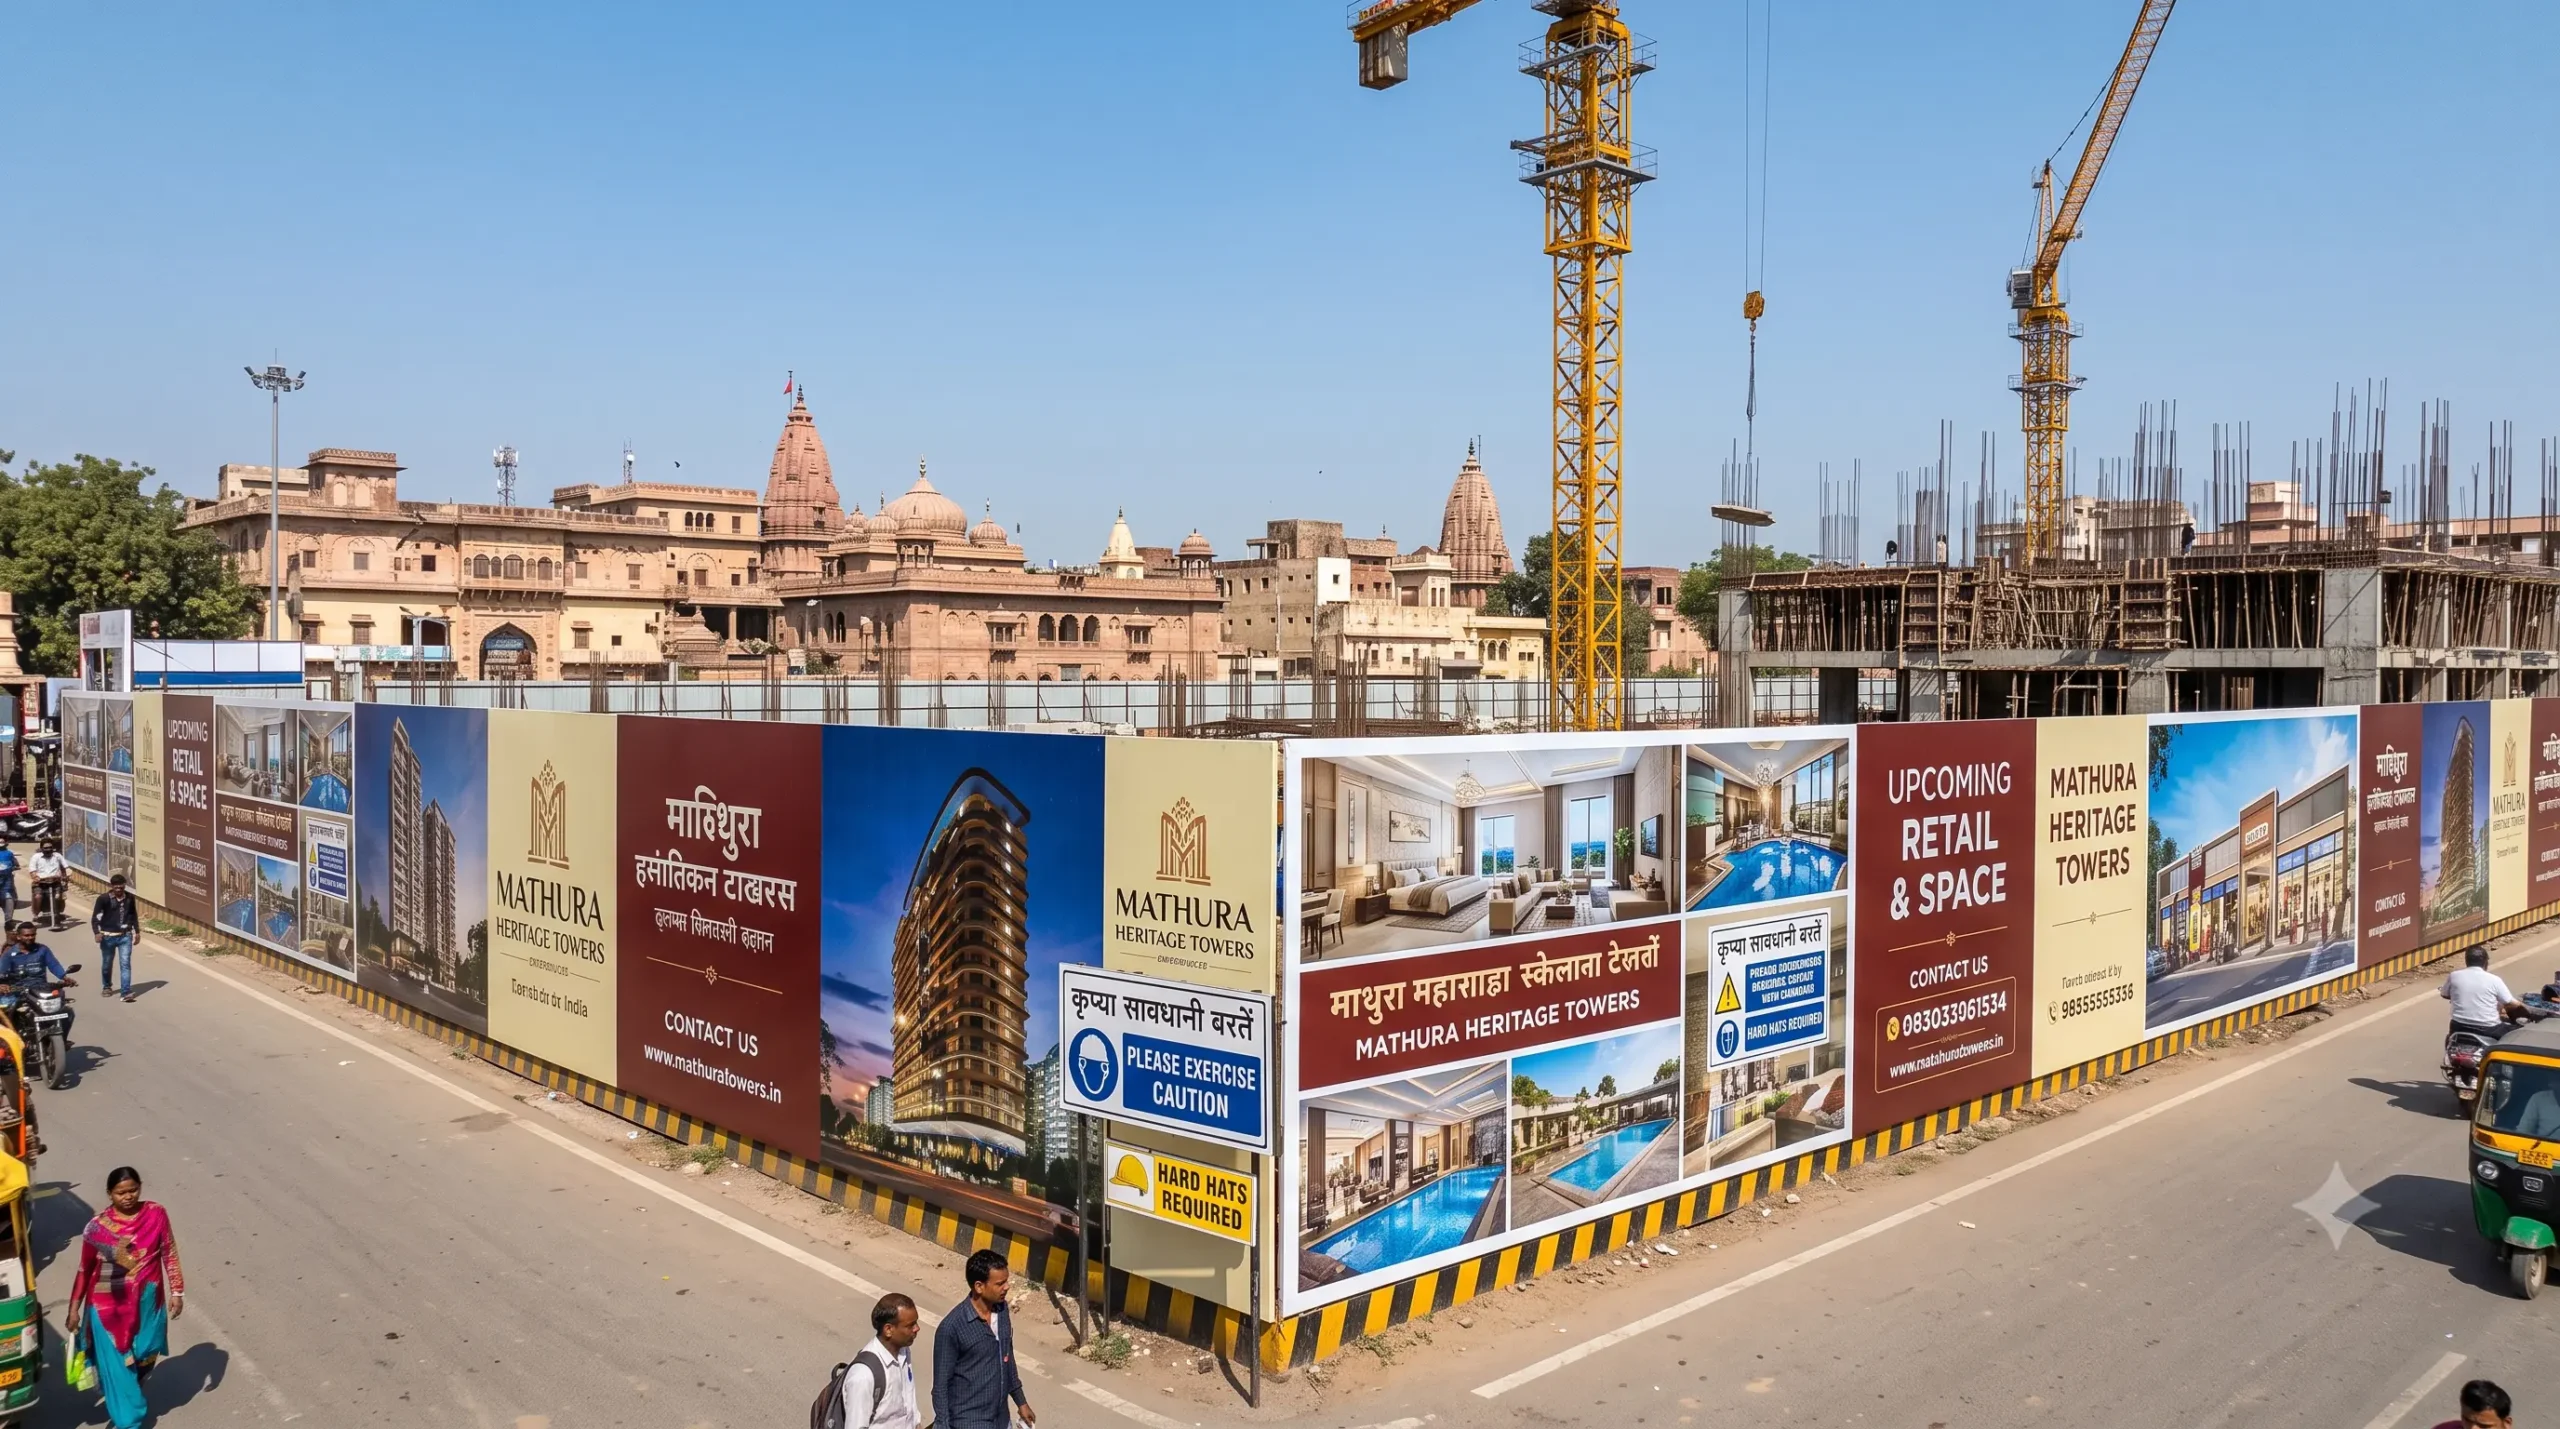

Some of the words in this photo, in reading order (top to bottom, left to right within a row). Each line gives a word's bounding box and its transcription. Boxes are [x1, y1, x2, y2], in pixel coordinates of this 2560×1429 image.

[167, 719, 208, 742] UPCOMING
[172, 748, 203, 776] RETAIL
[1888, 761, 2011, 804] UPCOMING
[2050, 762, 2137, 799] MATHURA
[169, 779, 176, 803] &
[177, 781, 208, 810] SPACE
[1902, 810, 1999, 861] RETAIL
[2050, 803, 2137, 843] HERITAGE
[2056, 846, 2130, 886] TOWERS
[497, 870, 605, 932] MATHURA
[1116, 887, 1254, 933] MATHURA
[1890, 876, 1910, 921] &
[1918, 861, 2007, 916] SPACE
[496, 916, 551, 949] HERITAGE
[553, 931, 605, 965] TOWERS
[1115, 924, 1186, 950] HERITAGE
[1189, 935, 1254, 960] TOWERS
[1749, 922, 1796, 953] सावधानी
[1909, 959, 1969, 989] CONTACT
[1972, 955, 1989, 975] US
[1071, 987, 1117, 1020] कृप्या
[1122, 997, 1205, 1033] सावधानी
[1210, 1006, 1254, 1041] बरतें
[1329, 980, 1408, 1026] माथुरा
[664, 1010, 734, 1049] CONTACT
[738, 1031, 759, 1057] US
[1356, 1022, 1459, 1061] MATHURA
[1465, 1003, 1559, 1041] HERITAGE
[1564, 989, 1640, 1022] TOWERS
[1747, 1024, 1767, 1041] HARD
[1769, 1020, 1787, 1036] HATS
[1788, 1011, 1822, 1031] REQUIRED
[644, 1044, 782, 1104] www.mathuratowers.in
[1127, 1045, 1180, 1076] PLEASE
[1184, 1056, 1256, 1091] EXERCISE
[1152, 1081, 1229, 1119] CAUTION
[1158, 1162, 1200, 1192] HARD
[1206, 1174, 1248, 1205] HATS
[1162, 1190, 1242, 1231] REQUIRED
